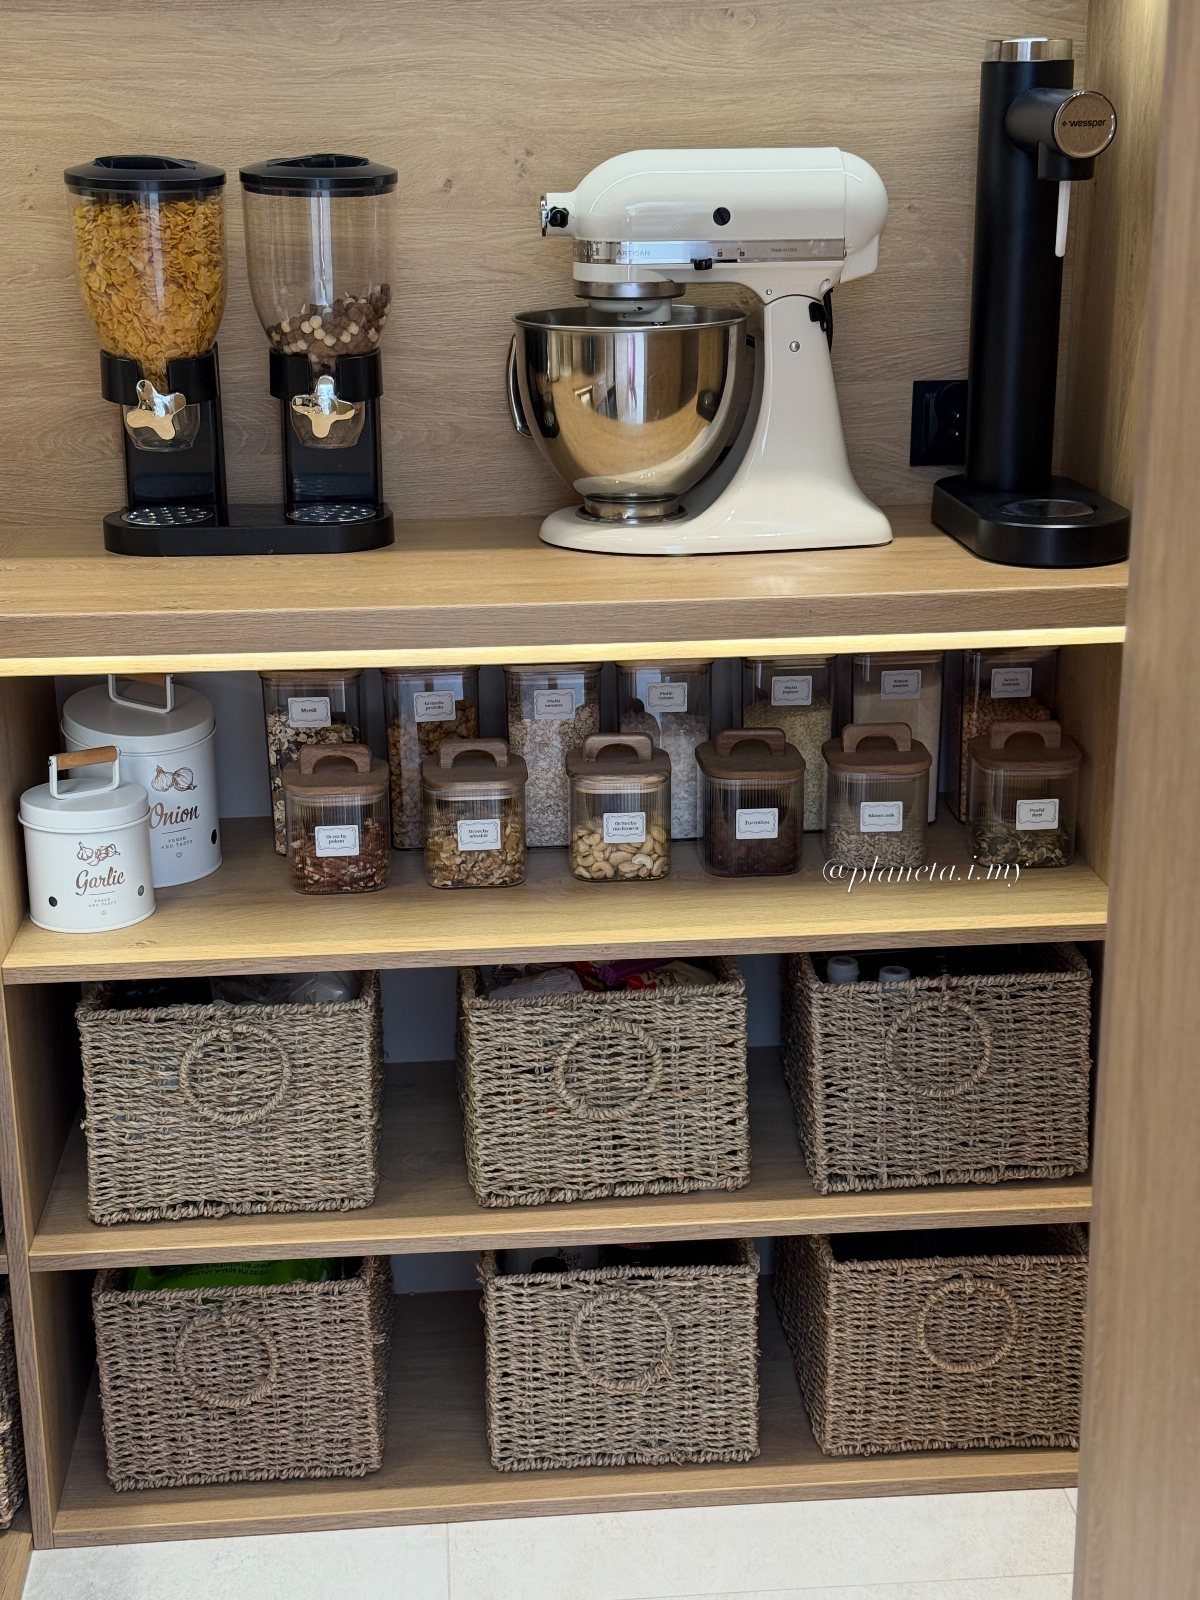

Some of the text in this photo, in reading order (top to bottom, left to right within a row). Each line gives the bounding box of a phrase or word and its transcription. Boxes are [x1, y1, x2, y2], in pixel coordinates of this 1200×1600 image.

[1069, 119, 1106, 129] wessper
[150, 801, 200, 830] Onion
[75, 866, 125, 896] Garlic
